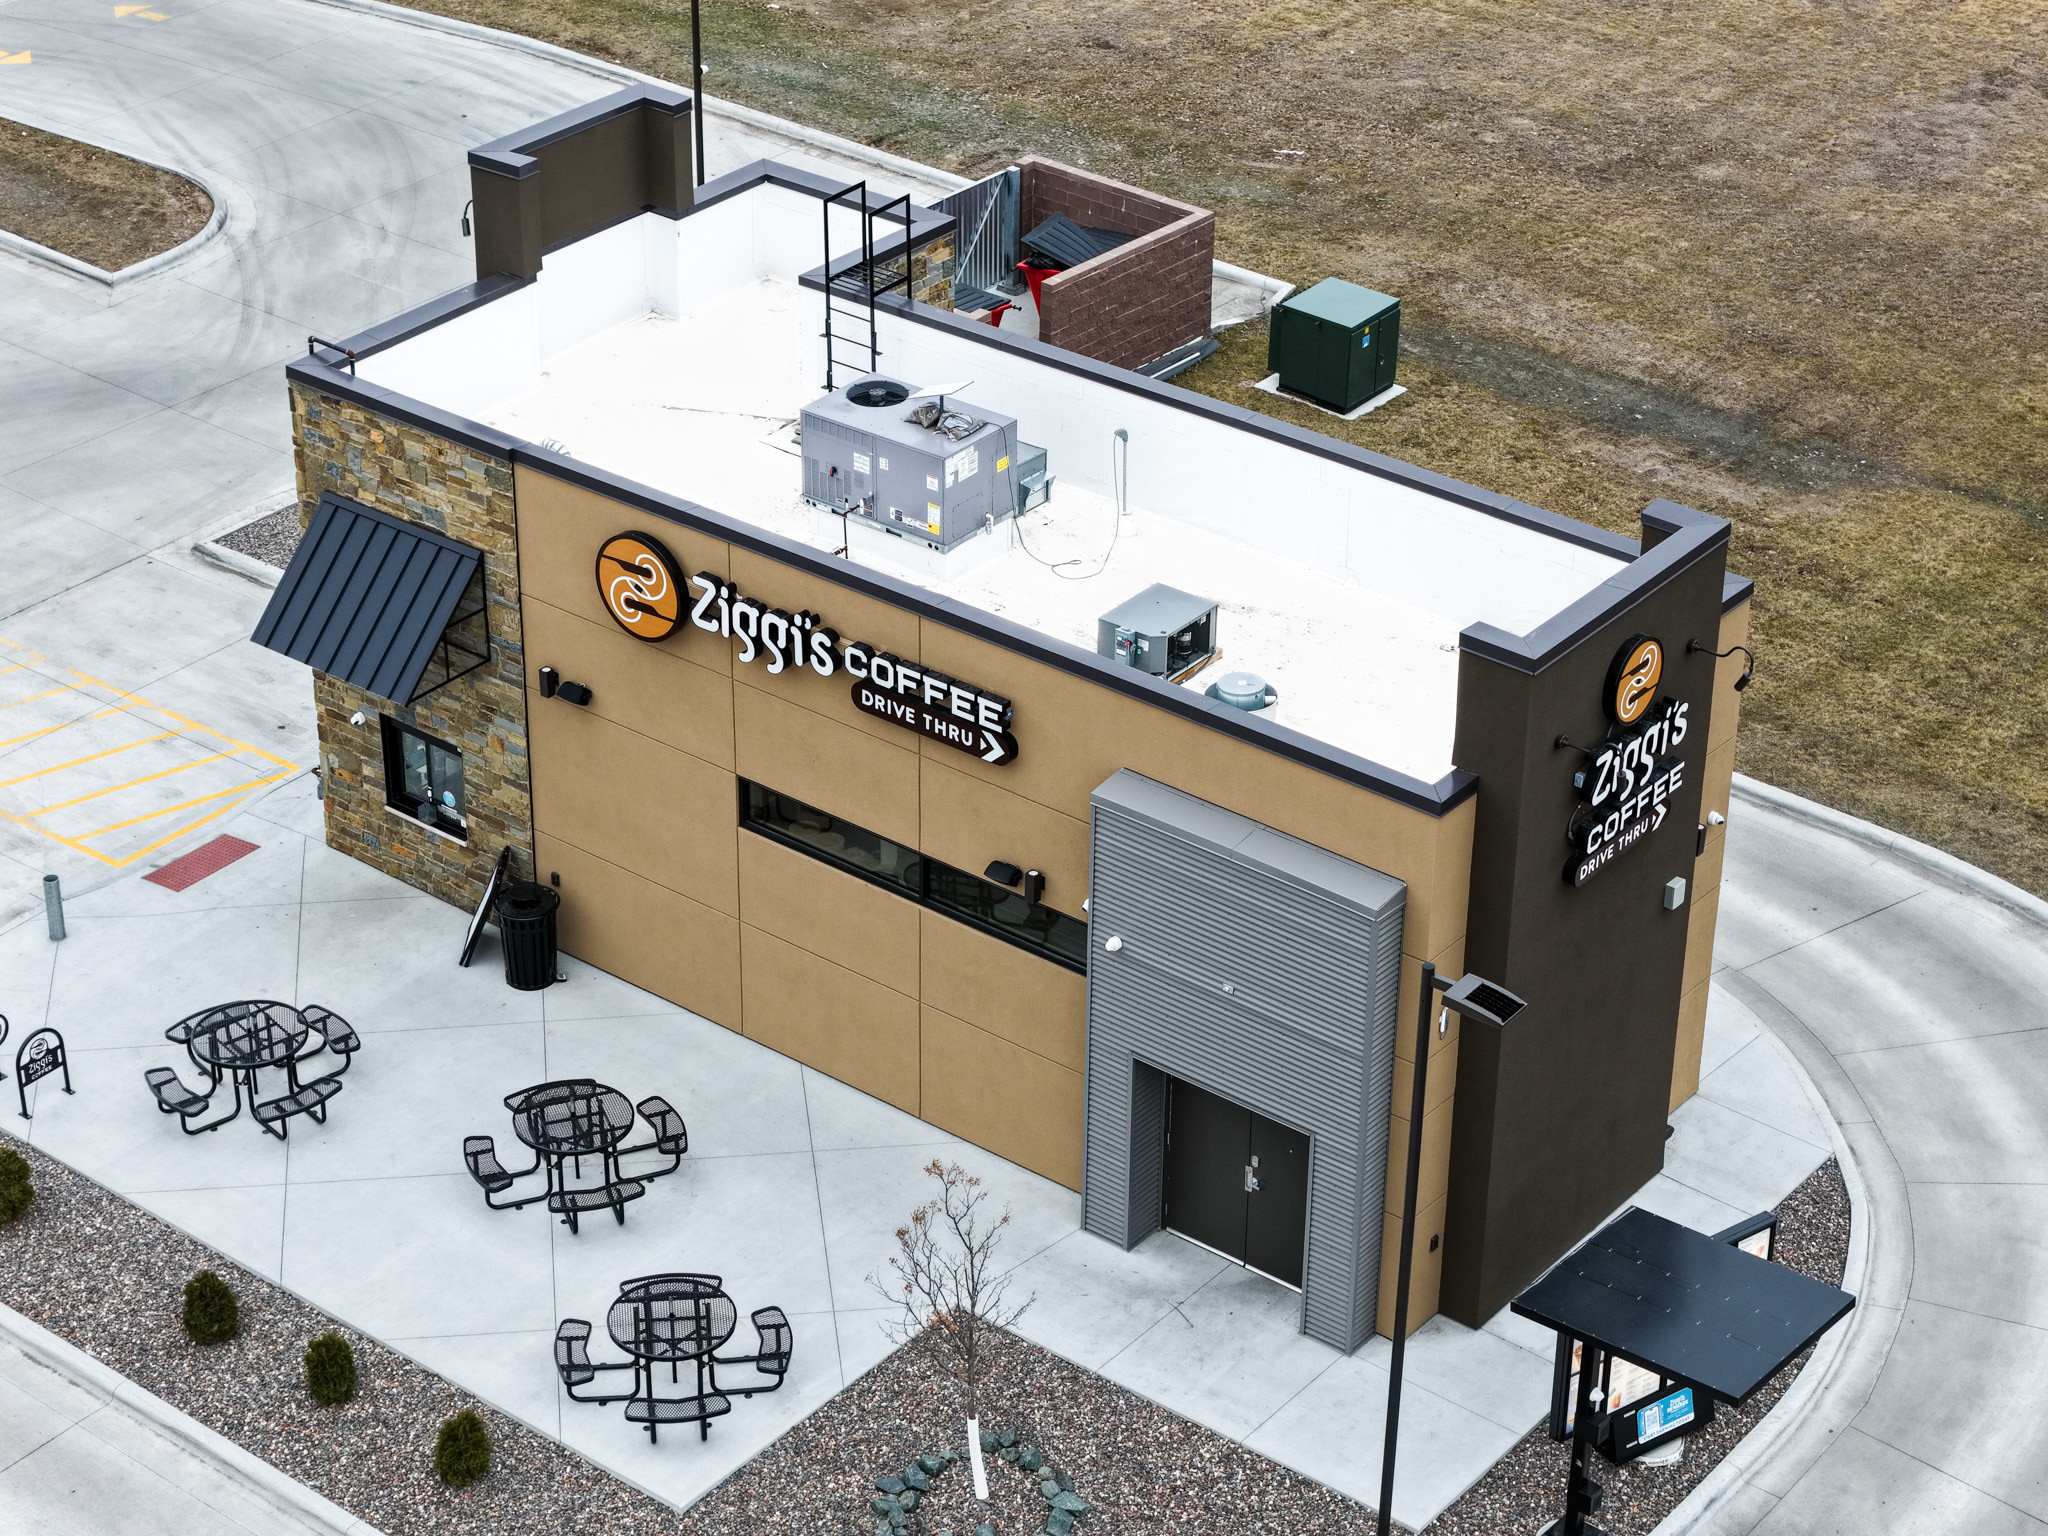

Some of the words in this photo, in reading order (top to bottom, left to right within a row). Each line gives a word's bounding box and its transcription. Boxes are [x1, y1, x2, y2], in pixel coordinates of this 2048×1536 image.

[691, 575, 834, 677] Ziggi's
[844, 646, 1003, 733] COFFEE
[861, 689, 916, 725] DRIVE
[922, 713, 973, 747] THRU
[1592, 701, 1689, 807] Ziggi's
[1586, 761, 1685, 855] COFFEE
[1579, 844, 1614, 881] DRIVE
[1618, 817, 1649, 851] THRU
[31, 1065, 53, 1080] COFFEE
[1643, 1431, 1656, 1441] START
[1656, 1422, 1676, 1435] EARNING
[1676, 1416, 1690, 1426] TODAY
